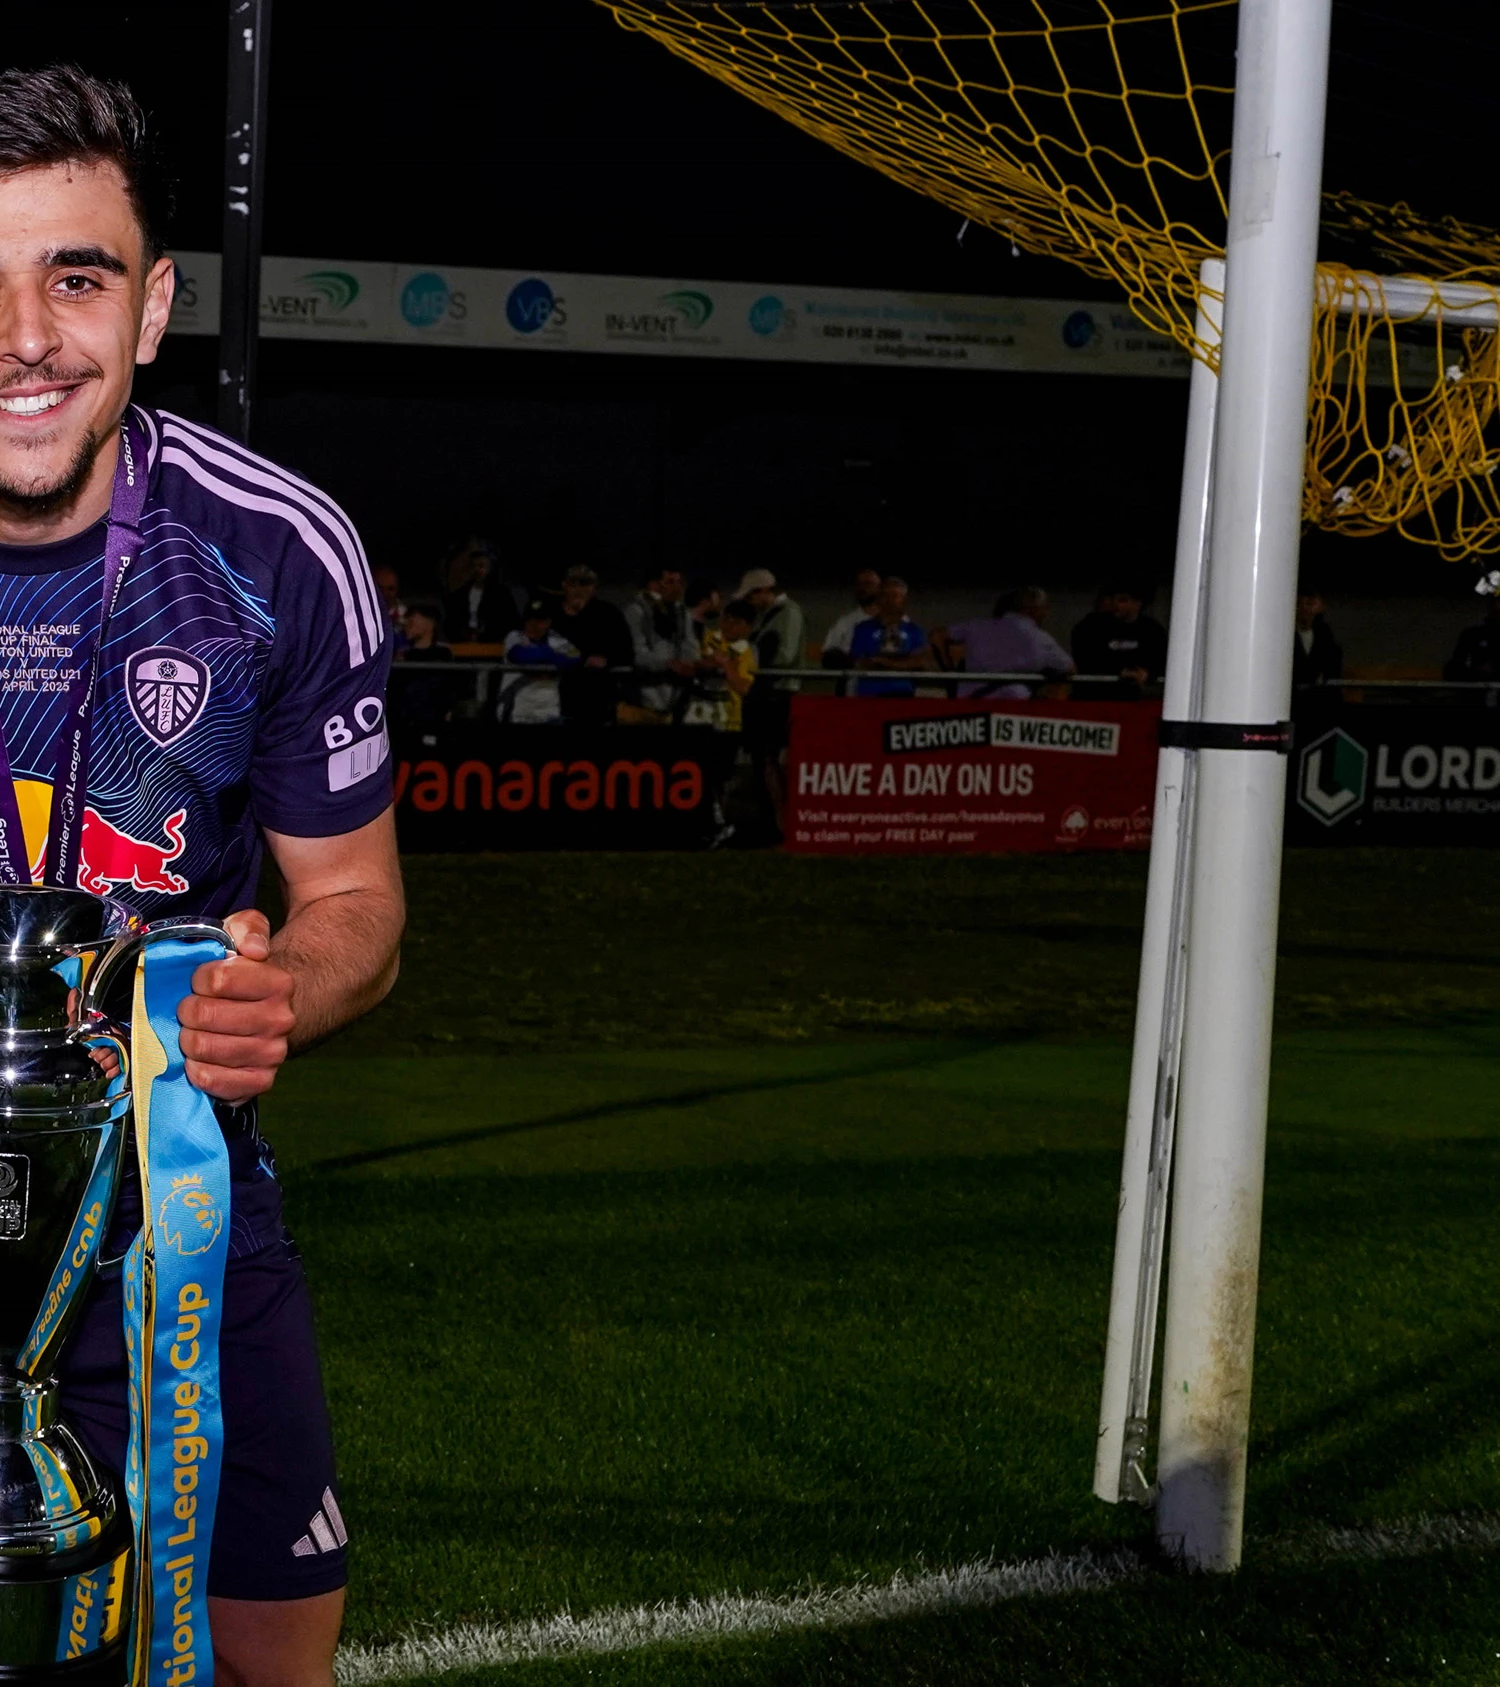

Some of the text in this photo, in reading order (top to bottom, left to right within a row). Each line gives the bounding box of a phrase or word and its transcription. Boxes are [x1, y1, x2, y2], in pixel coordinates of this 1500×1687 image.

[260, 294, 319, 316] -VENT
[516, 296, 568, 326] VBS
[604, 312, 676, 333] IN-VENT
[119, 424, 136, 488] League
[108, 555, 131, 618] Premie
[22, 635, 57, 646] FINAL
[33, 624, 81, 635] LEAGUE
[19, 657, 29, 669] V
[29, 646, 74, 658] UNITED
[1, 680, 39, 692] APRIL
[42, 681, 70, 692] 2025
[14, 668, 58, 680] UNITED
[60, 669, 82, 680] U21
[78, 655, 97, 718] Premier
[324, 696, 384, 749] BO
[889, 715, 1114, 752] EVERYONE IS WELCOME!
[66, 728, 82, 792] League
[1375, 744, 1500, 790] LORD
[797, 762, 1034, 796] HAVE A DAY ON US
[796, 810, 828, 823] Visit
[55, 823, 71, 885] Premier
[795, 830, 811, 843] to
[814, 829, 851, 843] claim
[854, 832, 883, 845] your
[885, 829, 917, 843] FREE
[919, 829, 945, 843] DAY
[169, 1282, 210, 1370] Cup
[167, 1383, 210, 1547] League
[162, 1552, 195, 1687] tional
